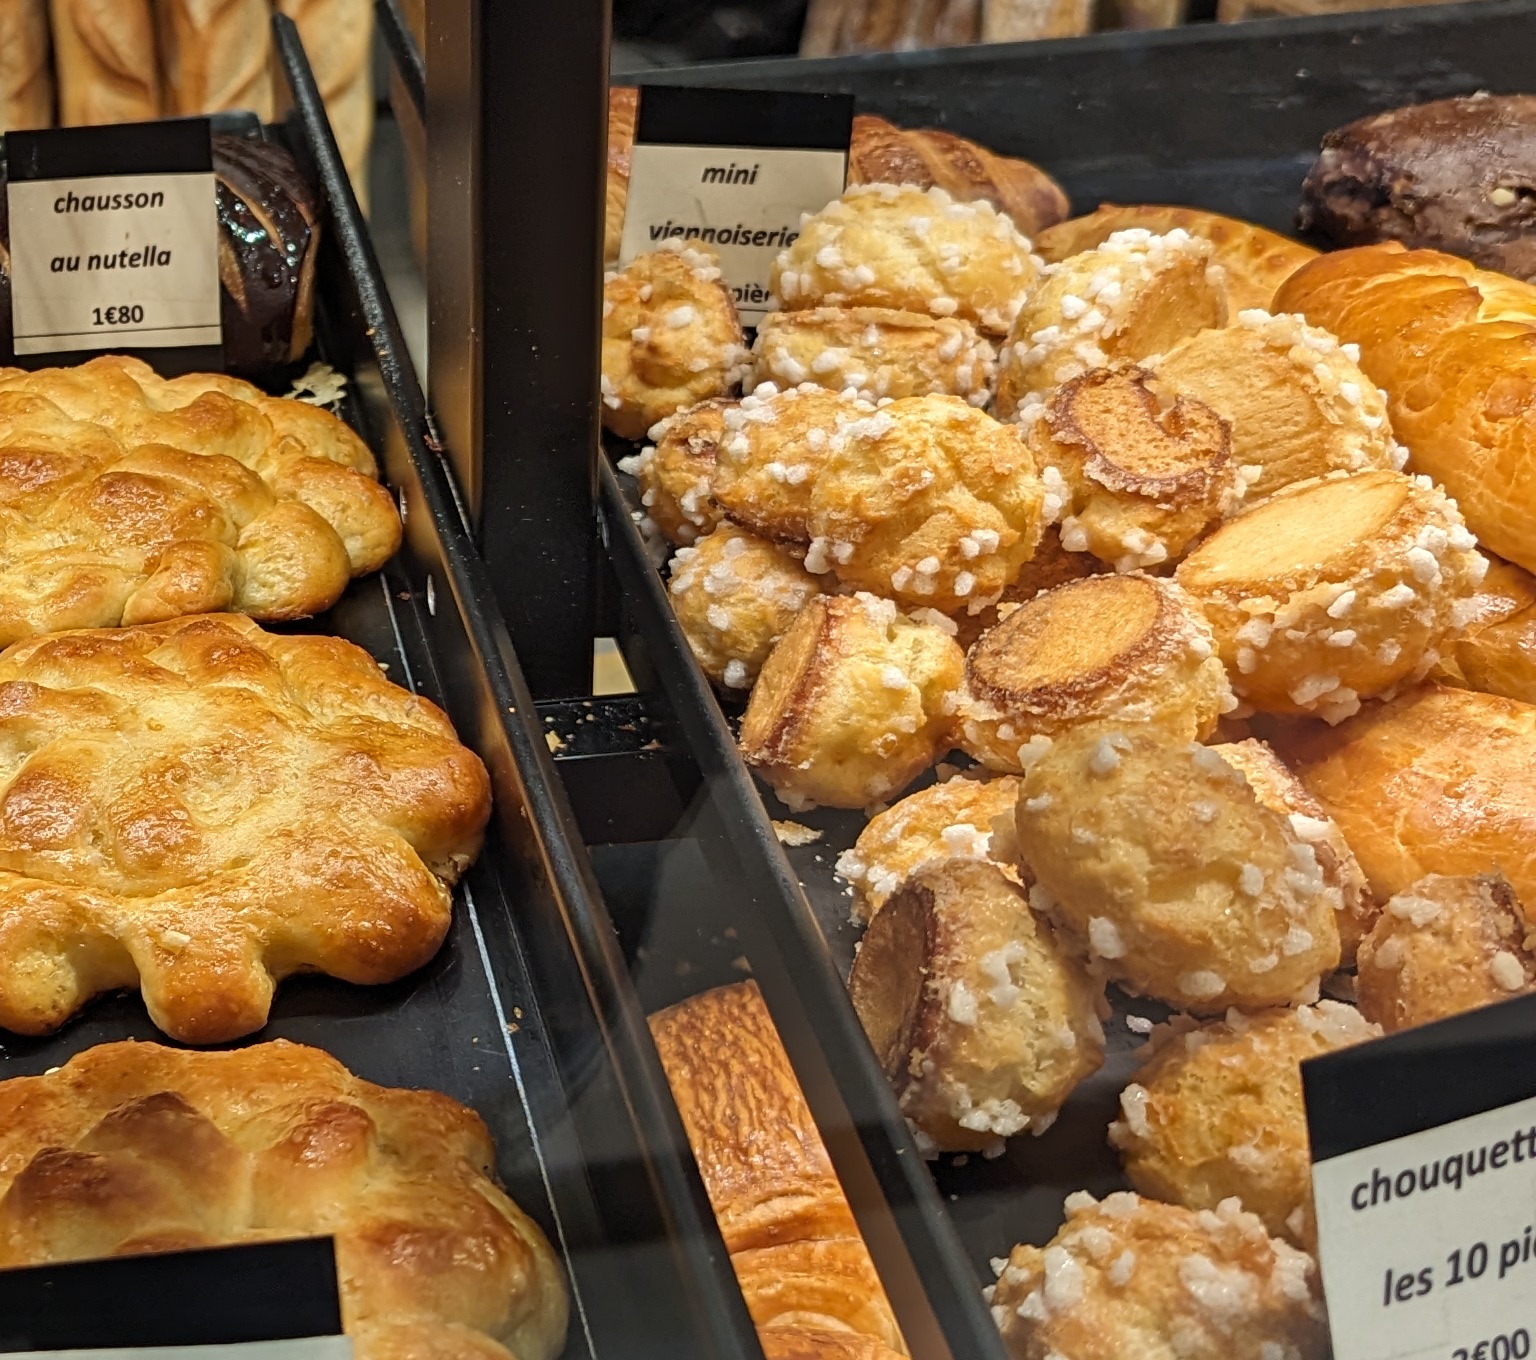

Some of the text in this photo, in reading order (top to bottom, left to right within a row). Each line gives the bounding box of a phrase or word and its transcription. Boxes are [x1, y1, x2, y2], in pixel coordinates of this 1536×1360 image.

[701, 163, 760, 185] mini
[53, 189, 165, 215] chausson
[50, 244, 172, 274] au nutella
[92, 304, 145, 327] 1€80
[1383, 1224, 1536, 1307] les 10 pi
